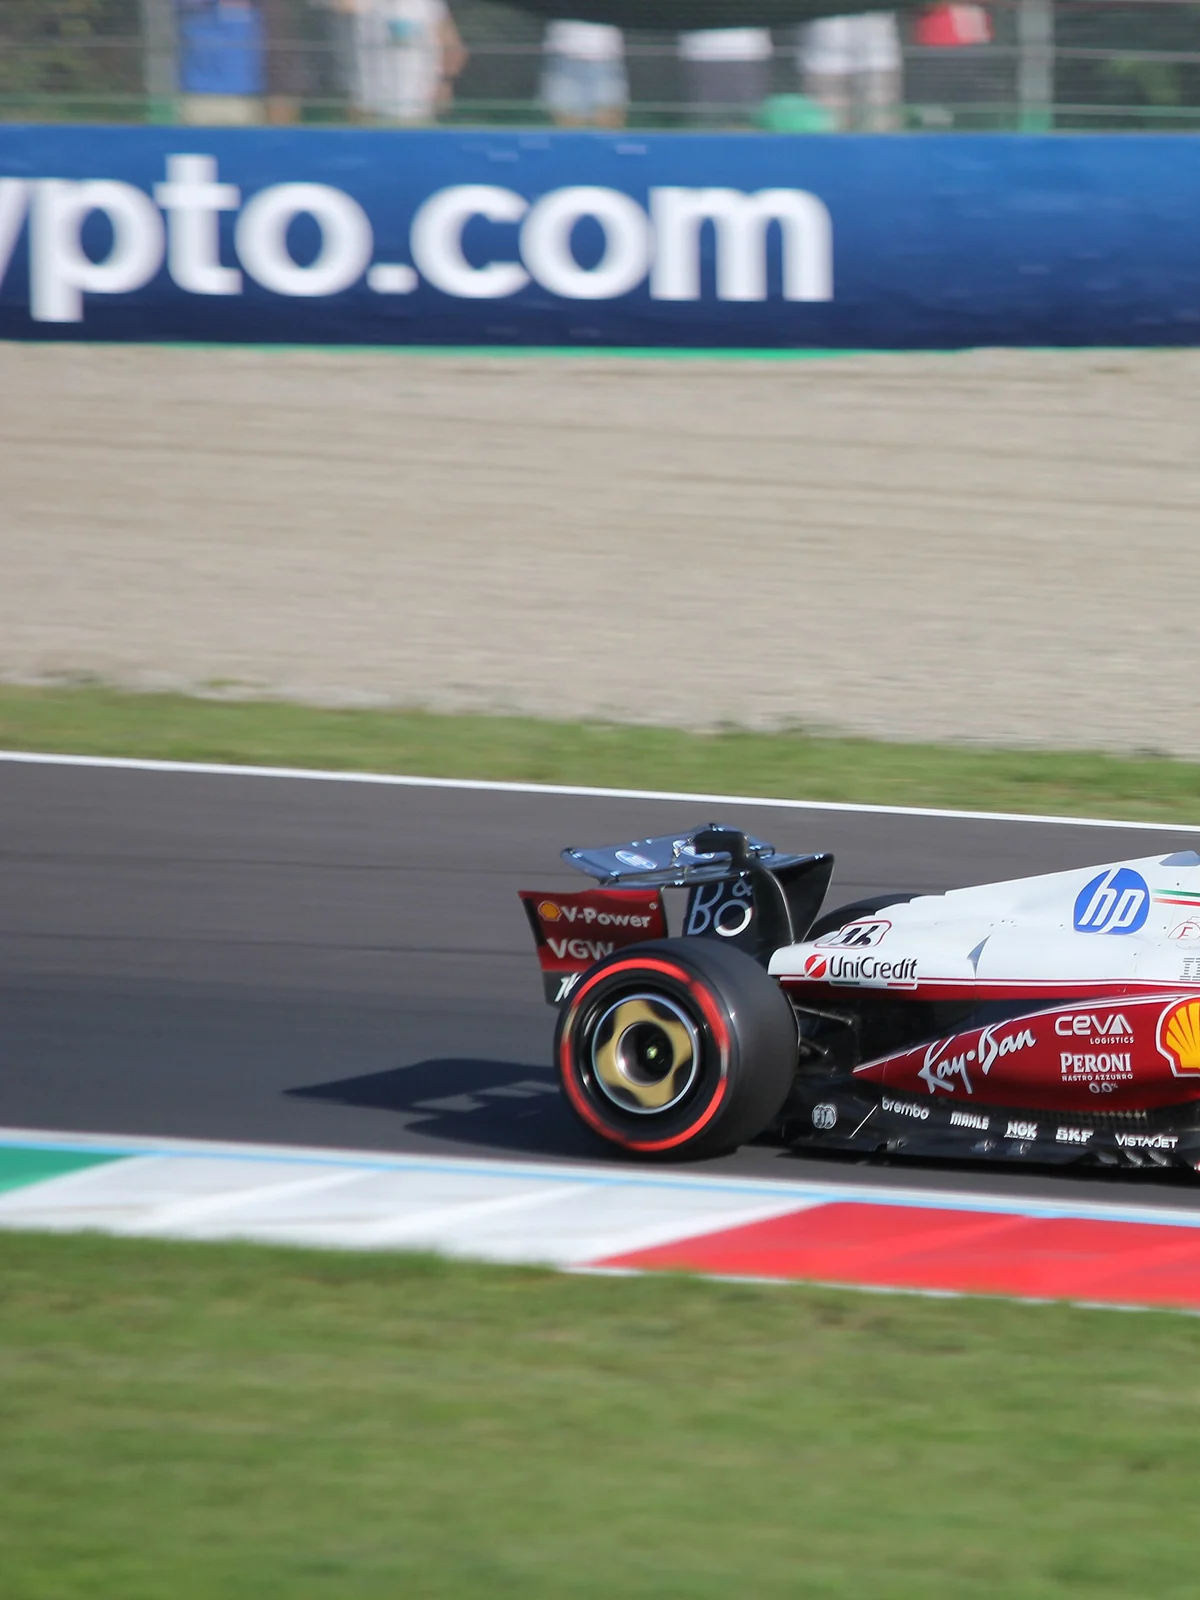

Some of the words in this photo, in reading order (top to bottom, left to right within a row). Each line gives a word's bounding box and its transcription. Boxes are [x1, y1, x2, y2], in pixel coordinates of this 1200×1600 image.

[1077, 867, 1146, 935] hp
[560, 905, 652, 928] V-Power
[829, 956, 918, 980] UniCredit
[1090, 1036, 1134, 1045] LOGISTICS
[1060, 1052, 1132, 1073] PERONI
[1062, 1074, 1093, 1082] NASTRO
[1095, 1073, 1133, 1081] AZZURRO
[881, 1096, 930, 1120] brembo
[950, 1111, 990, 1131] MAHLE
[1006, 1120, 1038, 1138] NGK
[1055, 1126, 1094, 1143] SKF
